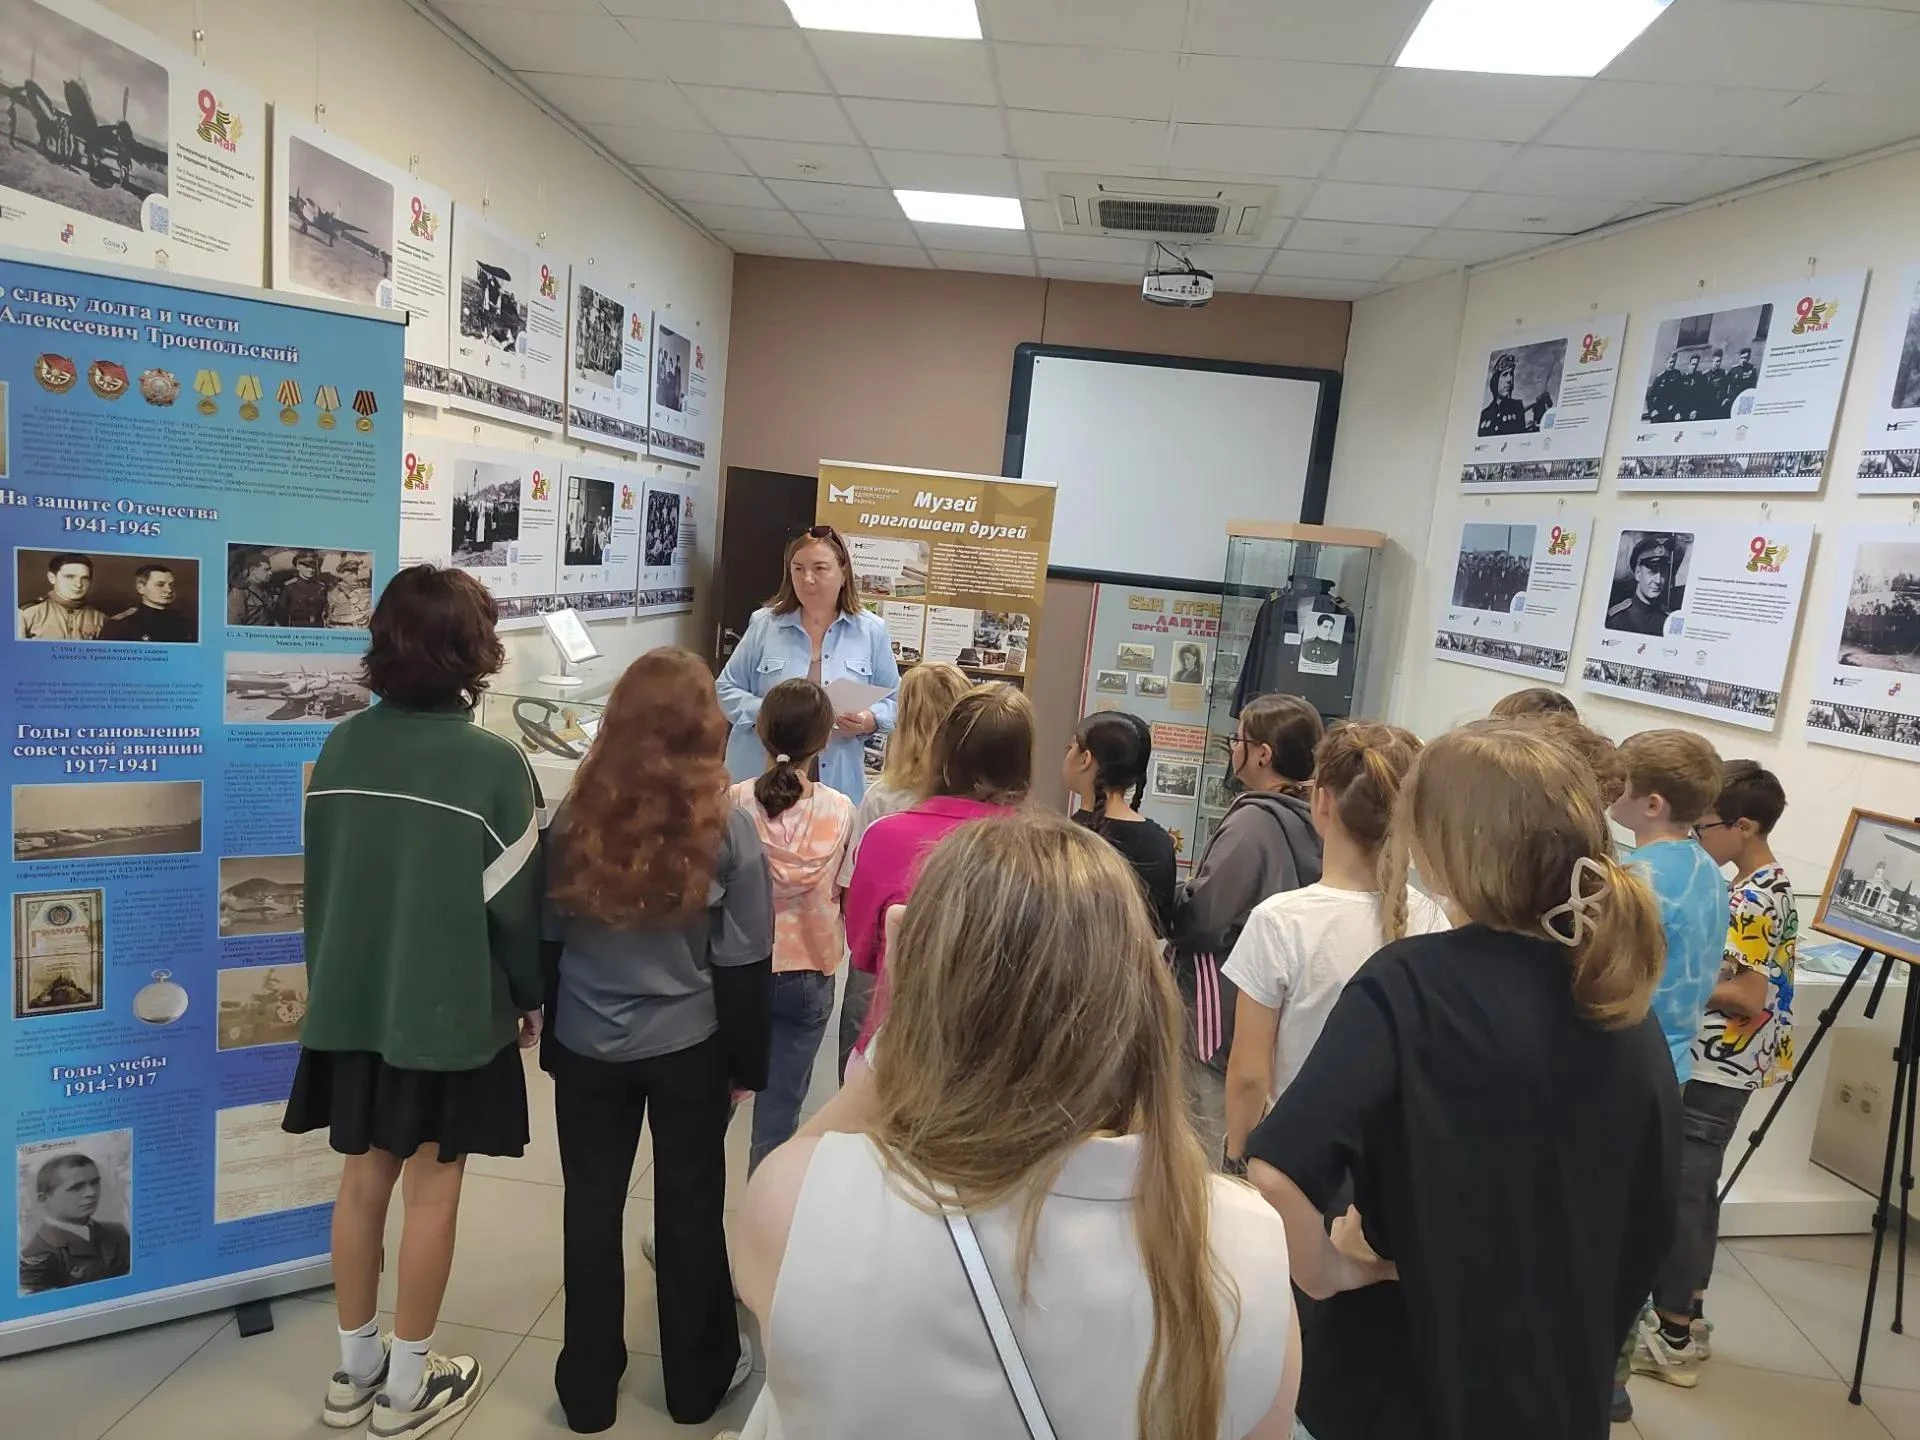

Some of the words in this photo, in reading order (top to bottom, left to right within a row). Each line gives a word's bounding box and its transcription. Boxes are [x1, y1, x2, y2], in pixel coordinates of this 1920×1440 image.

[12, 287, 80, 313] славу
[87, 299, 152, 320] долга
[159, 309, 173, 324] и
[179, 312, 240, 333] чести
[0, 305, 139, 341] Алексеевич
[146, 326, 299, 364] Троепольский
[0, 490, 28, 505] На
[34, 495, 111, 513] защите
[117, 499, 219, 521] Отечества
[913, 491, 978, 514] Музей
[64, 515, 161, 536] 1941-1945
[859, 512, 966, 534] приглашает
[969, 520, 1028, 540] друзей
[1128, 595, 1164, 613] СЫН
[17, 724, 70, 740] Годы
[77, 725, 201, 739] становления
[13, 742, 116, 757] советской
[123, 744, 204, 758] авиации
[65, 758, 157, 774] 1917-1941
[53, 1064, 102, 1081] Годы
[108, 1055, 167, 1077] учебы
[65, 1072, 157, 1097] 1914-1917
